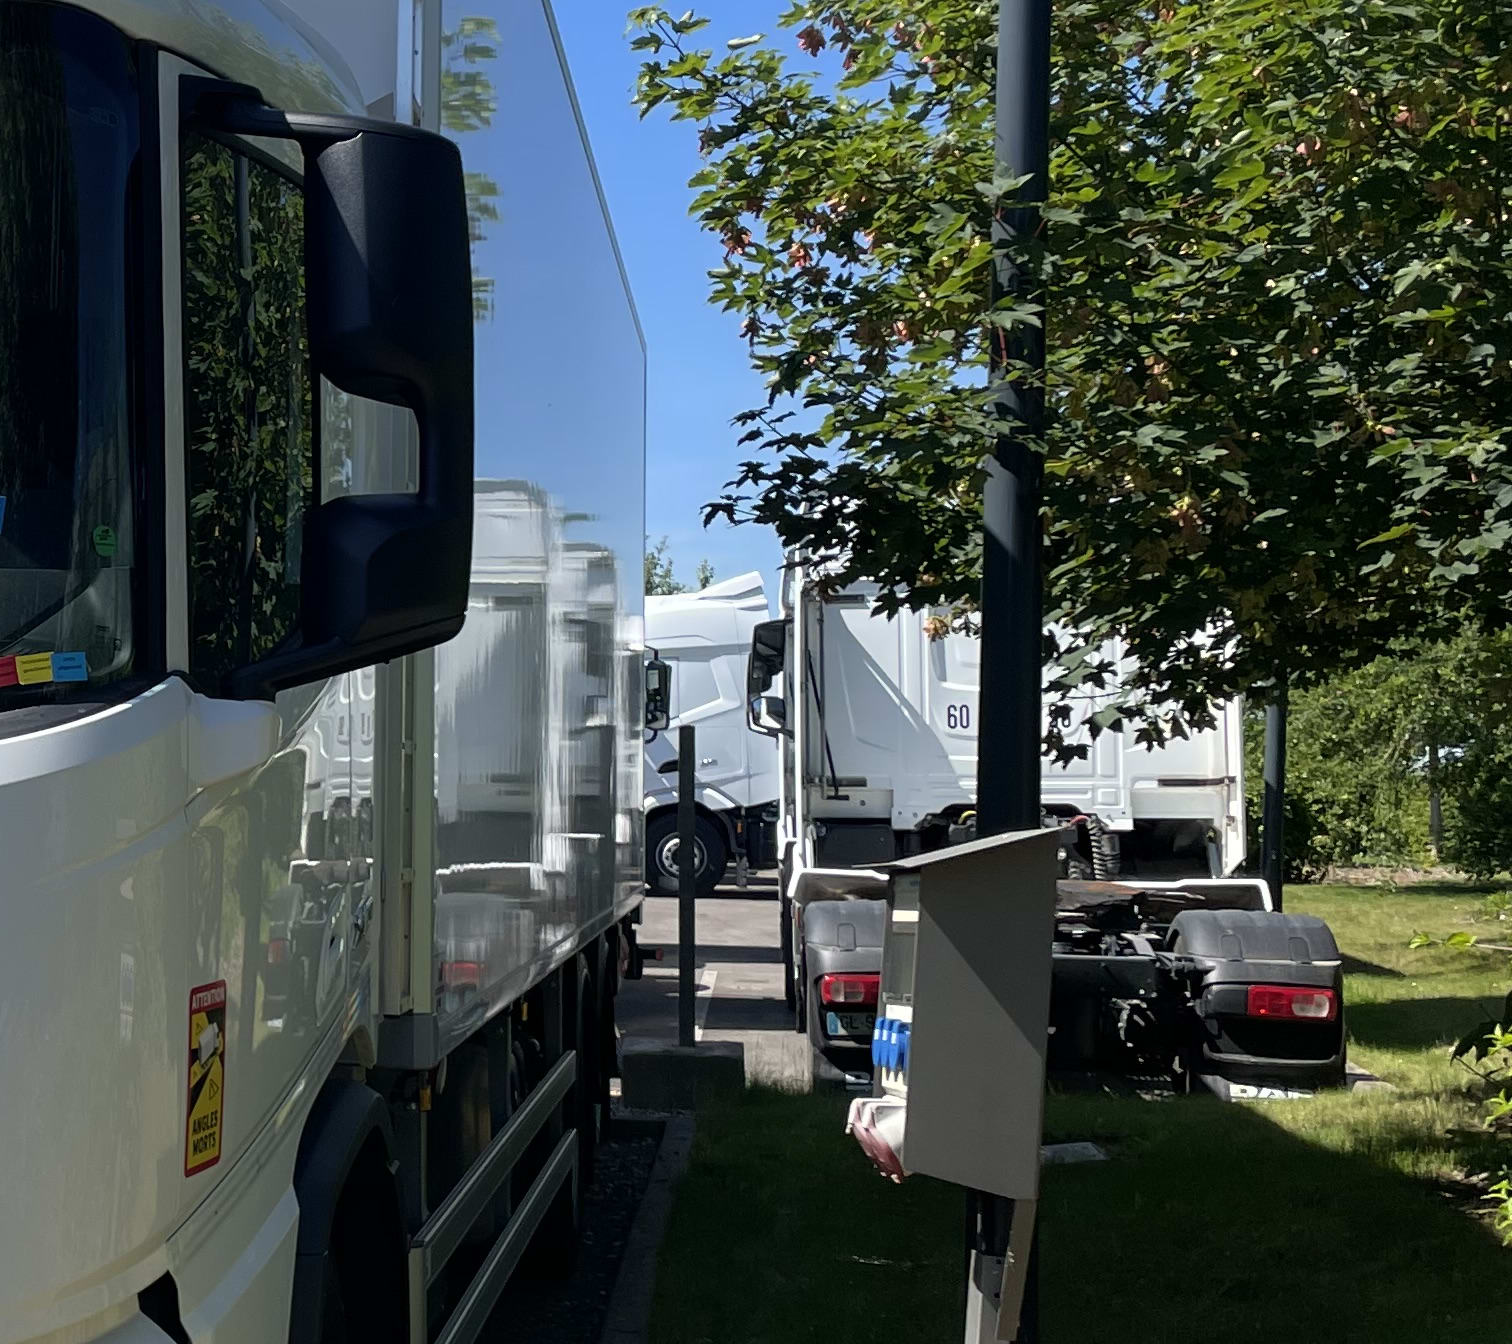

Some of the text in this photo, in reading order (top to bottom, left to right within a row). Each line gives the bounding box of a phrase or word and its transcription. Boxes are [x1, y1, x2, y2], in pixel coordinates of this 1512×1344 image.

[947, 704, 970, 729] 60
[192, 1109, 219, 1134] ANGLES
[192, 1130, 217, 1157] MORTS
